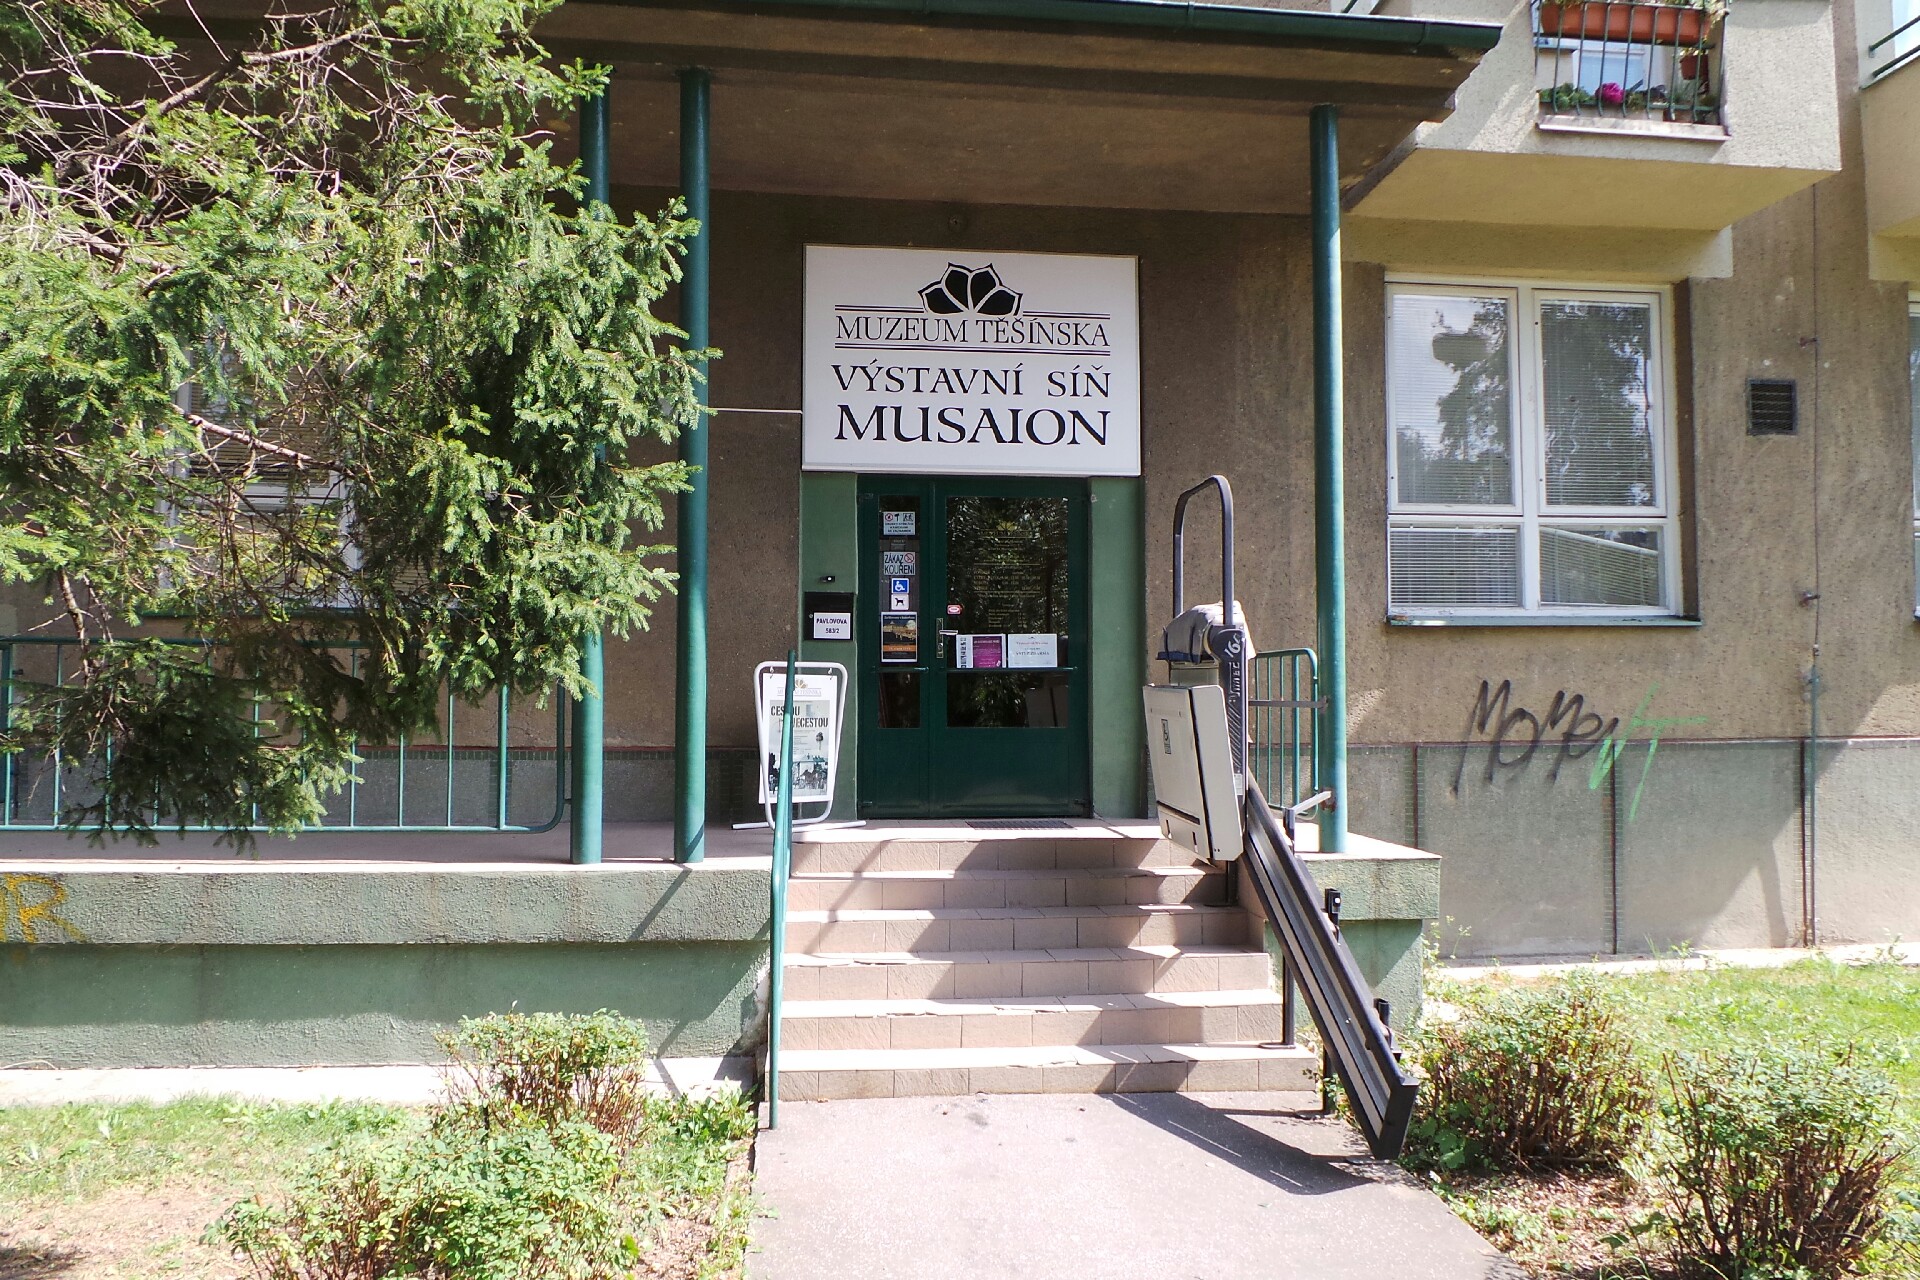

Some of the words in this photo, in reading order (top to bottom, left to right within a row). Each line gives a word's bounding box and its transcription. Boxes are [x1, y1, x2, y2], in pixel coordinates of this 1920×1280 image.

[835, 316, 968, 343] MUZEUM
[976, 318, 1111, 347] TĚŠÍNSKA
[831, 358, 1024, 396] VÝSTAVNÍ
[1047, 364, 1111, 398] SÍŇ
[834, 404, 1111, 446] MUSAION
[885, 553, 904, 564] ZÁKAZ
[885, 563, 915, 575] KOUŘENÍ
